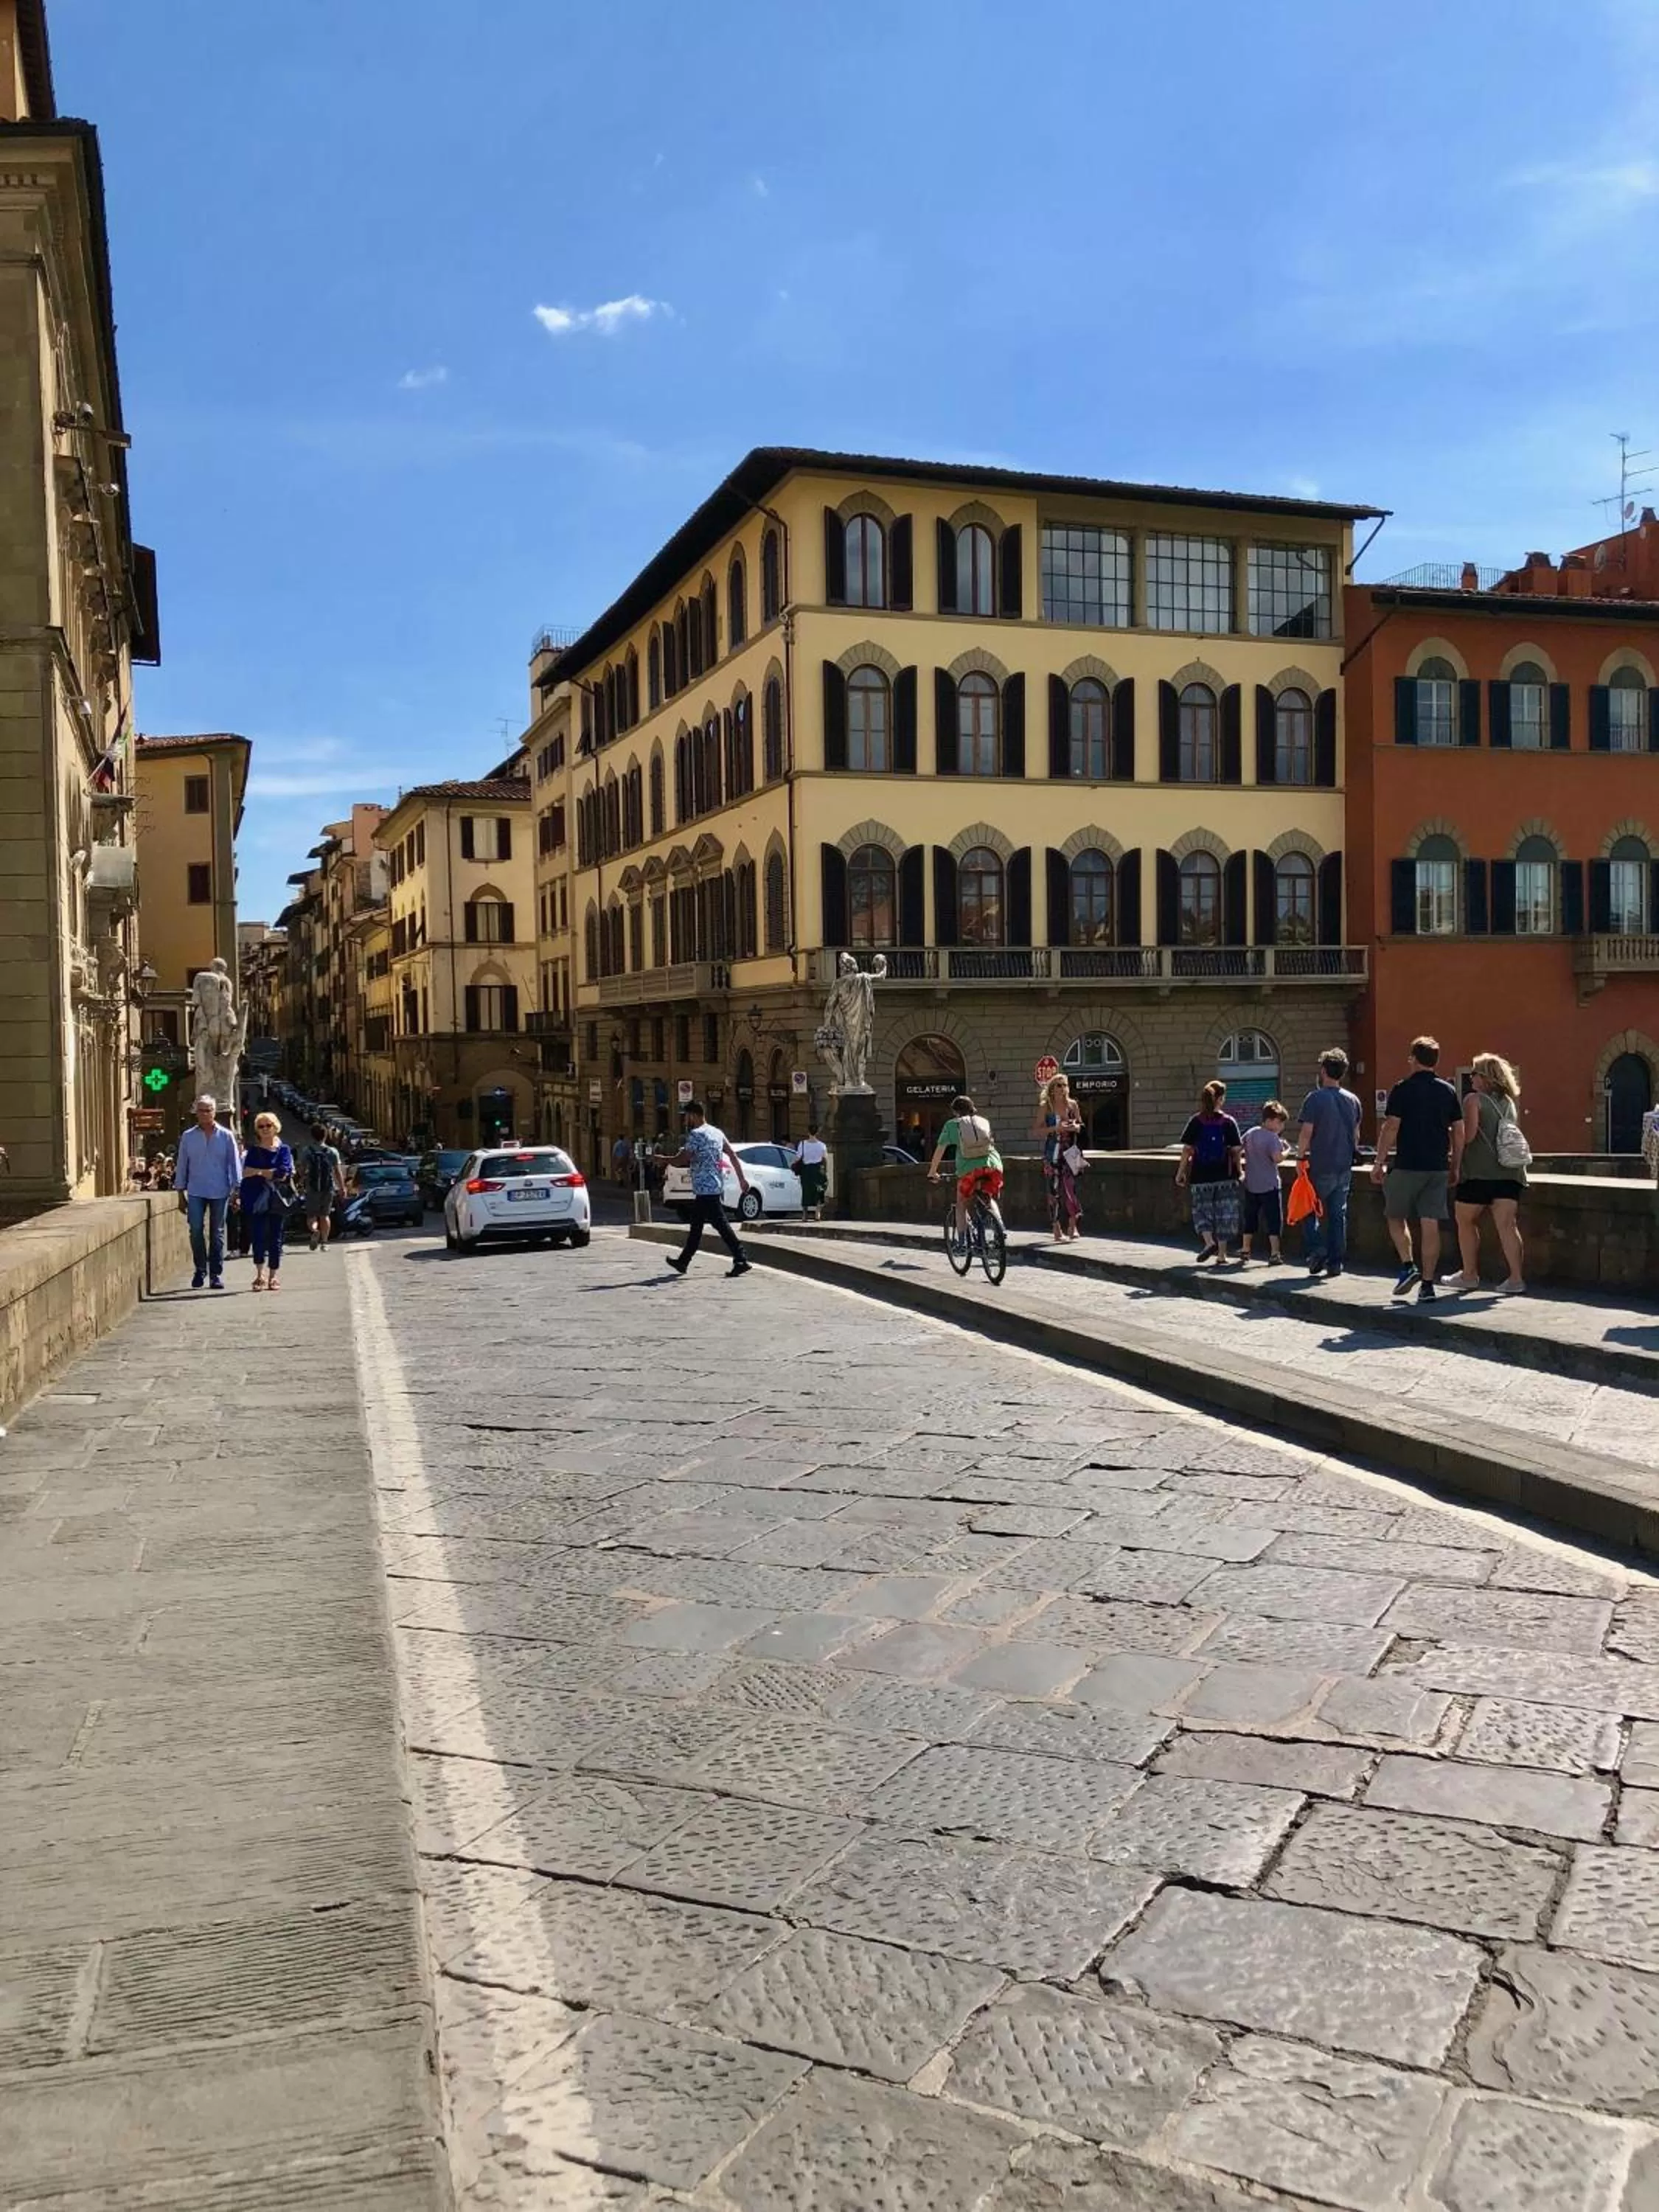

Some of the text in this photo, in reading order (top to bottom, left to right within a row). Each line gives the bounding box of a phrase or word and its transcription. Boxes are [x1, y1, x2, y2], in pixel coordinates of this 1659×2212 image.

[1037, 1067, 1057, 1078] STOP
[906, 1085, 956, 1093] GELATERIA
[1077, 1080, 1117, 1089] EMPORIO
